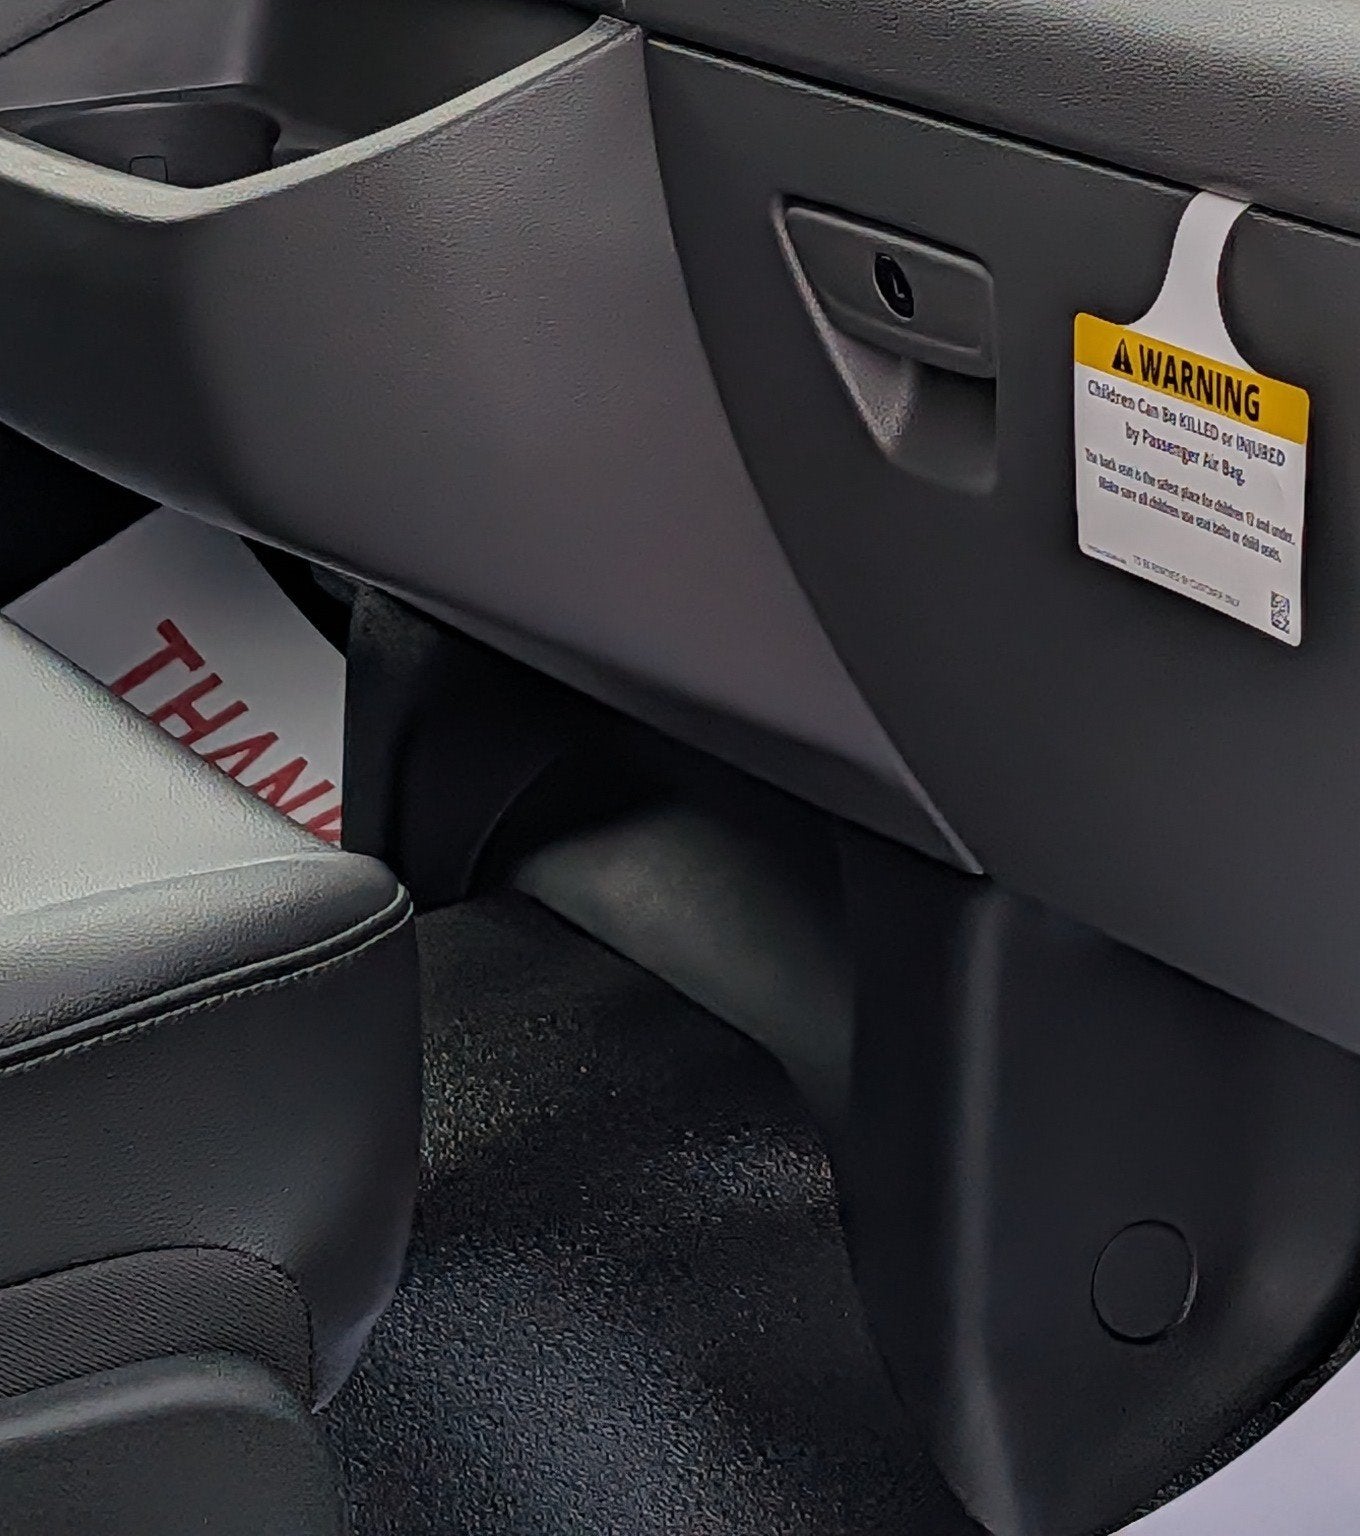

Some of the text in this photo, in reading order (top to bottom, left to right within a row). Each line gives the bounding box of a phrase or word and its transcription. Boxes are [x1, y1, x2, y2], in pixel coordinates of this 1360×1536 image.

[1139, 344, 1260, 422] WARNING
[1088, 379, 1285, 466] Children Can Be KILLED or INJURED
[1125, 421, 1139, 445] by
[1142, 428, 1200, 464] Passenger
[1203, 452, 1219, 471] Air
[1149, 496, 1180, 518] children
[1181, 487, 1200, 504] place
[1214, 500, 1244, 522] children
